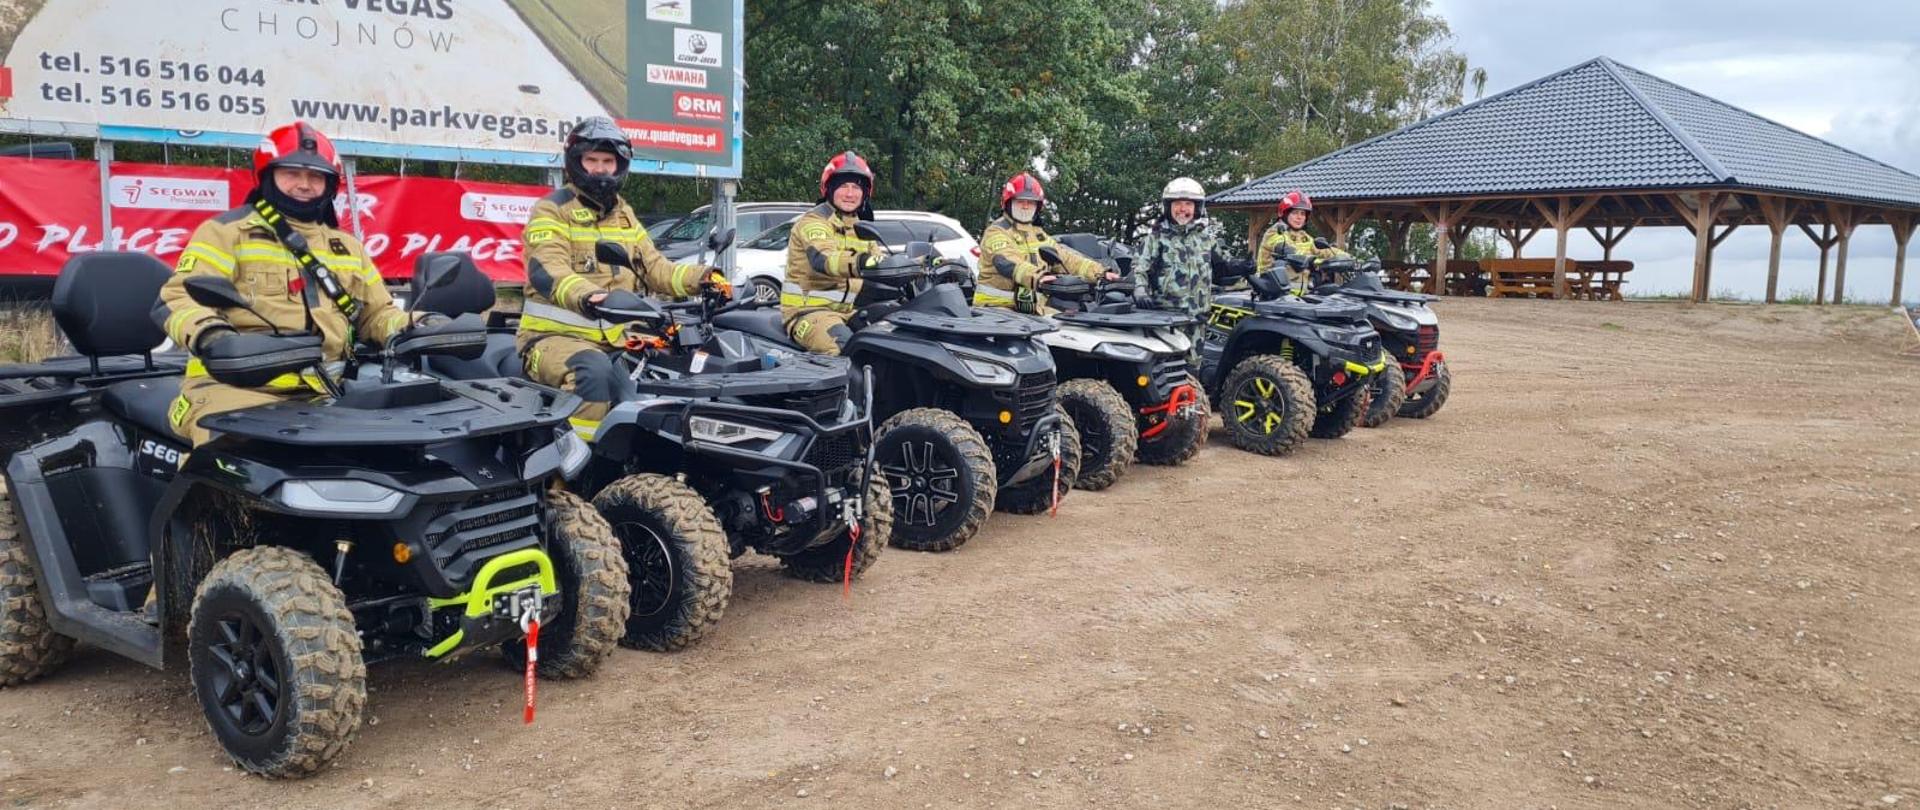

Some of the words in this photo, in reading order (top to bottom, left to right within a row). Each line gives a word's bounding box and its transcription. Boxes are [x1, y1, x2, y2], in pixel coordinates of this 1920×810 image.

[221, 7, 454, 52] CHOJNÓW
[39, 51, 90, 73] tel.
[100, 55, 150, 78] 516
[160, 60, 209, 82] 516
[217, 66, 266, 87] 044
[663, 69, 704, 85] YAMAHA
[41, 82, 92, 104] tel.
[101, 86, 152, 108] 516
[161, 90, 210, 112] 516
[218, 94, 266, 116] 055
[149, 187, 217, 197] SEGWAY
[331, 192, 378, 222] AR
[491, 203, 534, 212] SEGW
[142, 440, 182, 465] SEG
